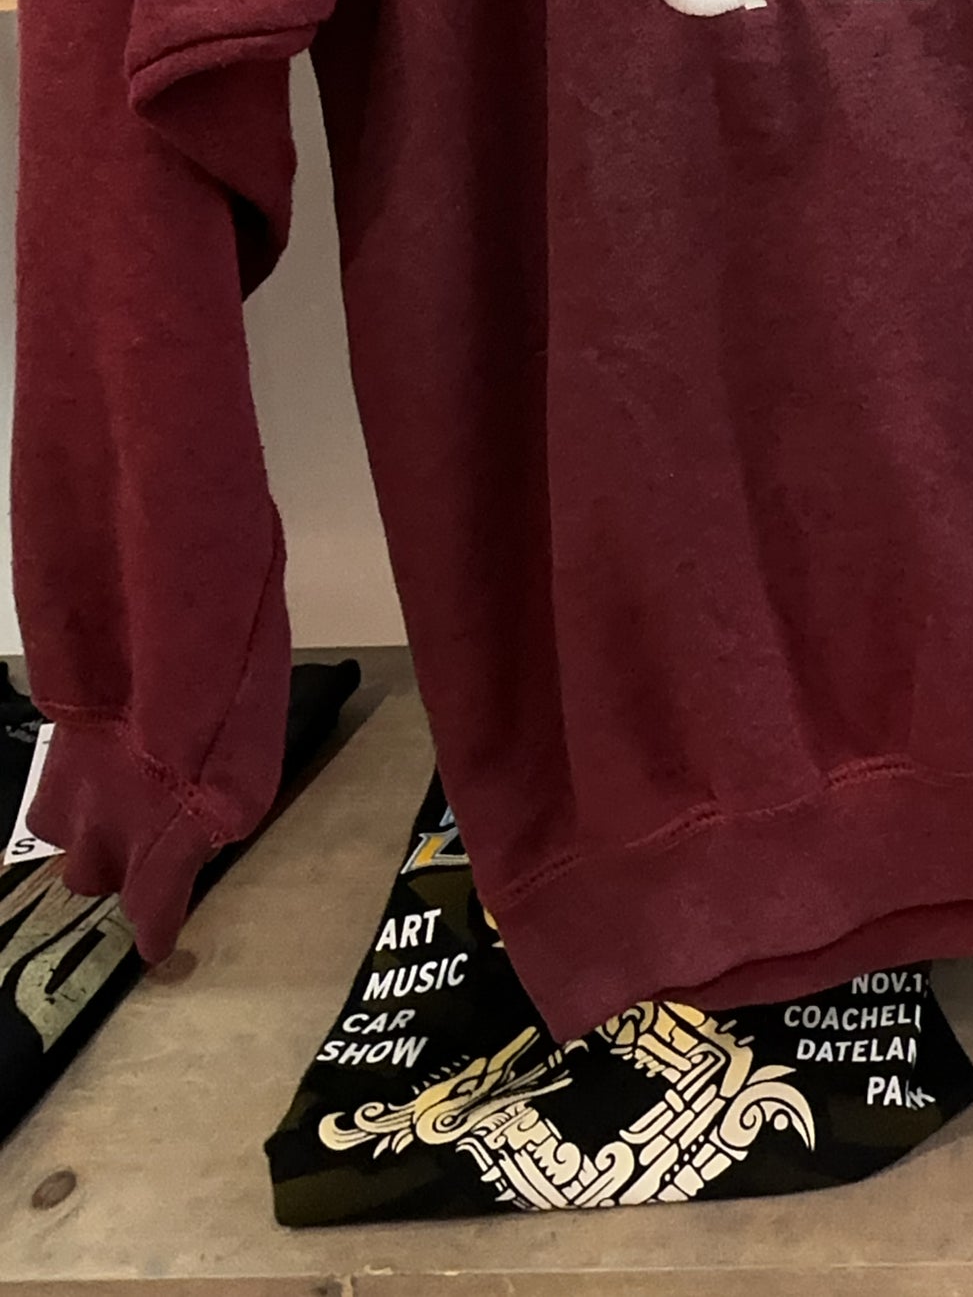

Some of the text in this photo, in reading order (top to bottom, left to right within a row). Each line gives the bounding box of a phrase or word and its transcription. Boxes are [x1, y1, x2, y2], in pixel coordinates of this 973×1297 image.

[375, 908, 442, 952] ART
[362, 952, 469, 1002] MUSIC
[851, 972, 929, 998] NOV.1
[342, 1009, 416, 1035] CAR
[316, 1036, 429, 1069] SHOW
